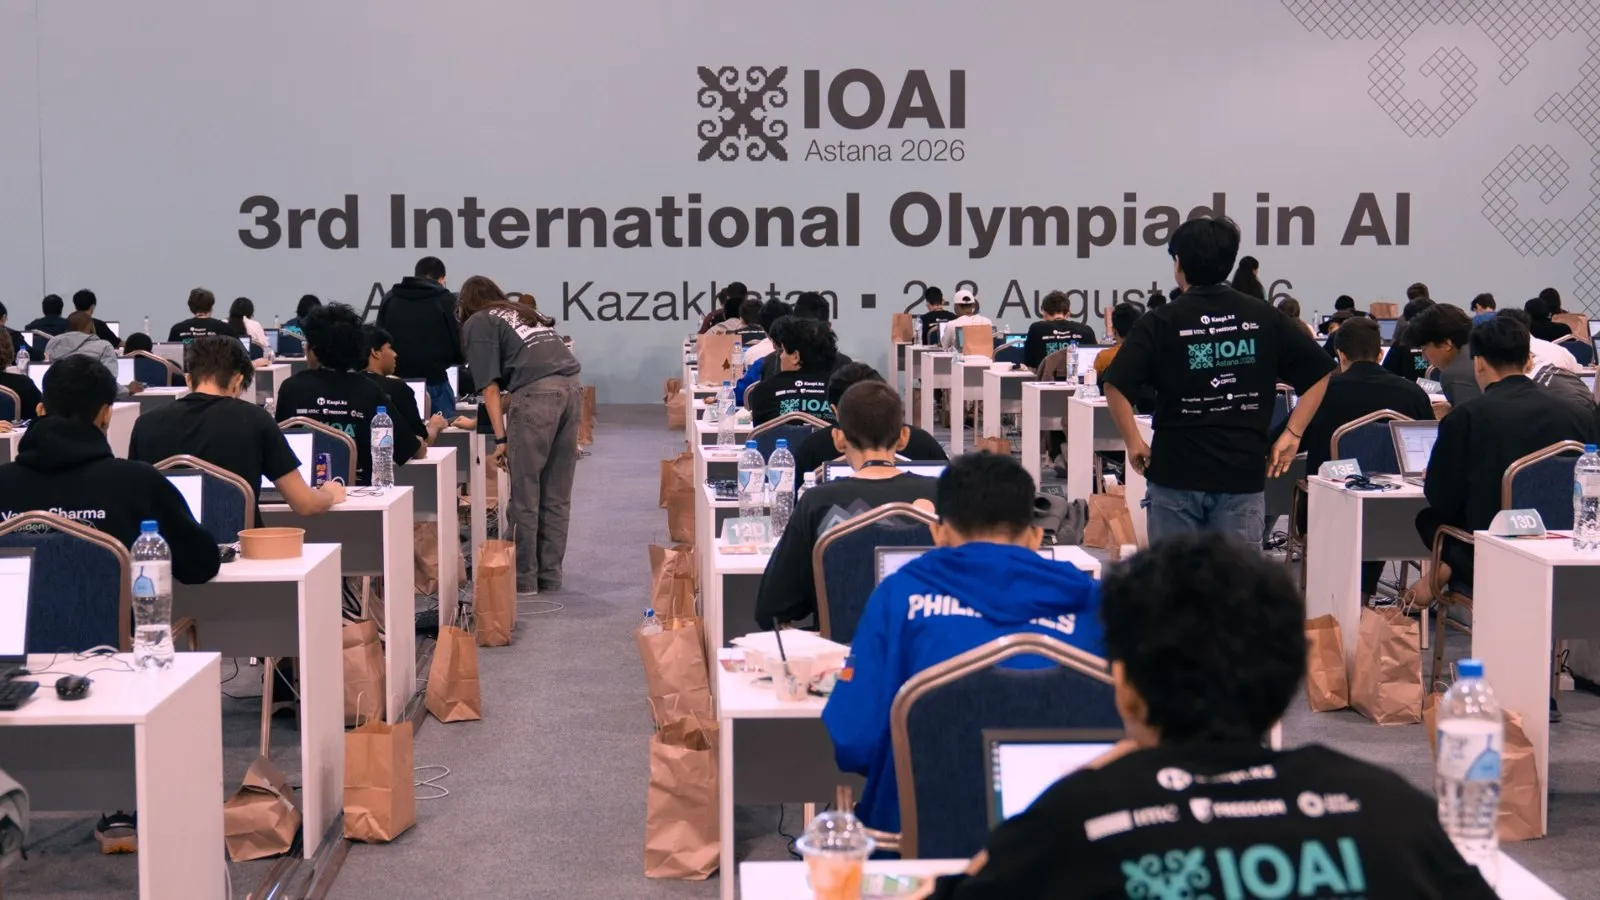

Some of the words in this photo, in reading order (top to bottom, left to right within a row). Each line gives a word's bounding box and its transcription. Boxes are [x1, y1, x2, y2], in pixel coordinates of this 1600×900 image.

[804, 68, 966, 130] IOAI
[805, 139, 892, 162] Astana
[900, 139, 965, 162] 2026
[238, 194, 360, 250] 3rd
[390, 192, 861, 248] International
[1255, 191, 1315, 246] in
[1340, 191, 1411, 246] AI
[563, 280, 838, 321] Kazaktn
[1215, 339, 1256, 358] IOAI
[1216, 359, 1239, 367] Astana
[801, 399, 832, 412] IOA
[48, 508, 106, 519] Sharma
[1510, 514, 1538, 529] 13D
[1214, 836, 1365, 900] IOAI
